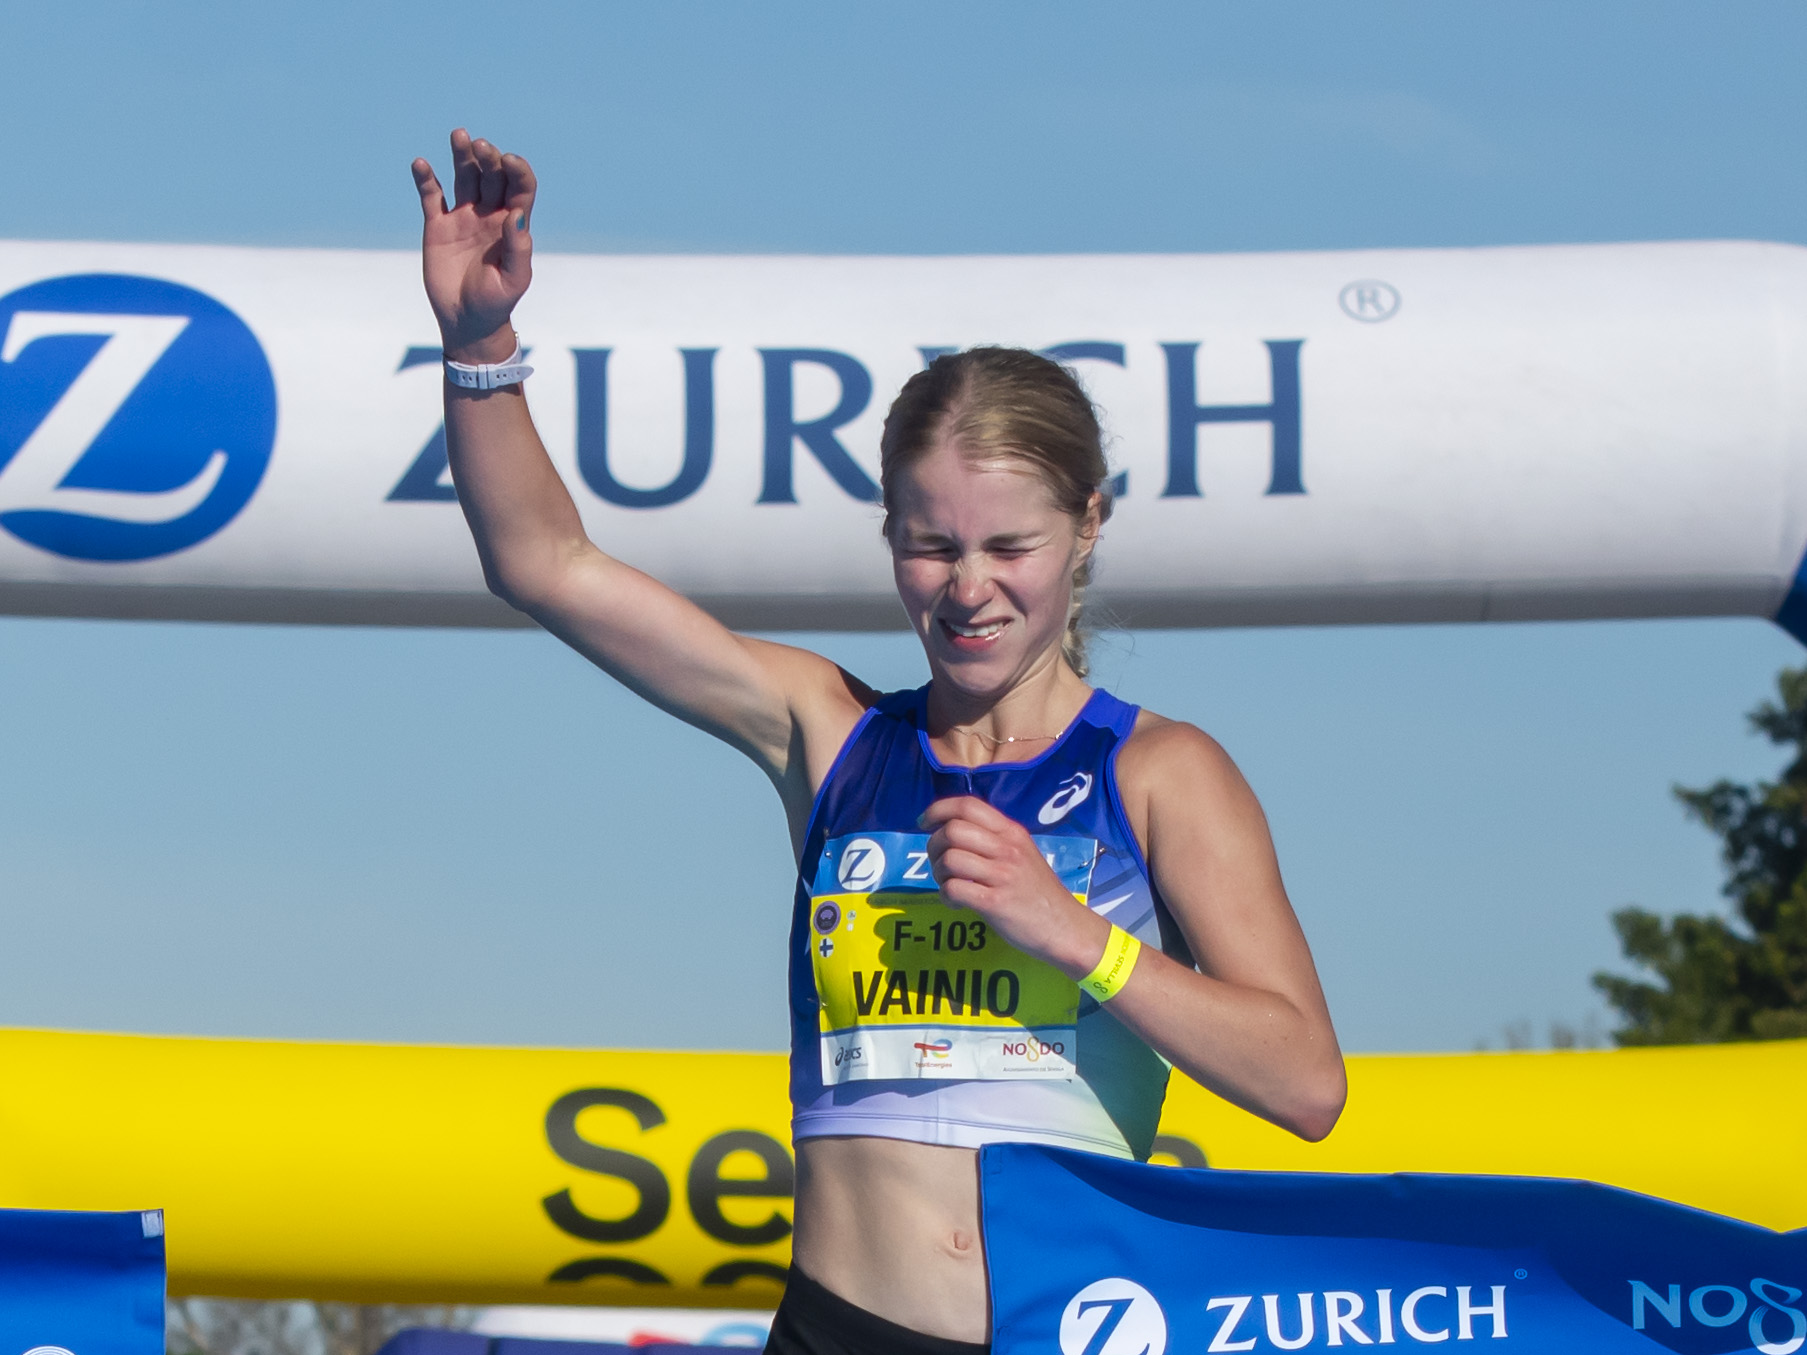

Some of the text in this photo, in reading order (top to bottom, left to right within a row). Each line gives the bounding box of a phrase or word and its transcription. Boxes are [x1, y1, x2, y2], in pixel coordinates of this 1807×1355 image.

[893, 920, 988, 952] F-103
[852, 968, 1021, 1018] VAINIO
[1206, 1284, 1509, 1353] ZURICH
